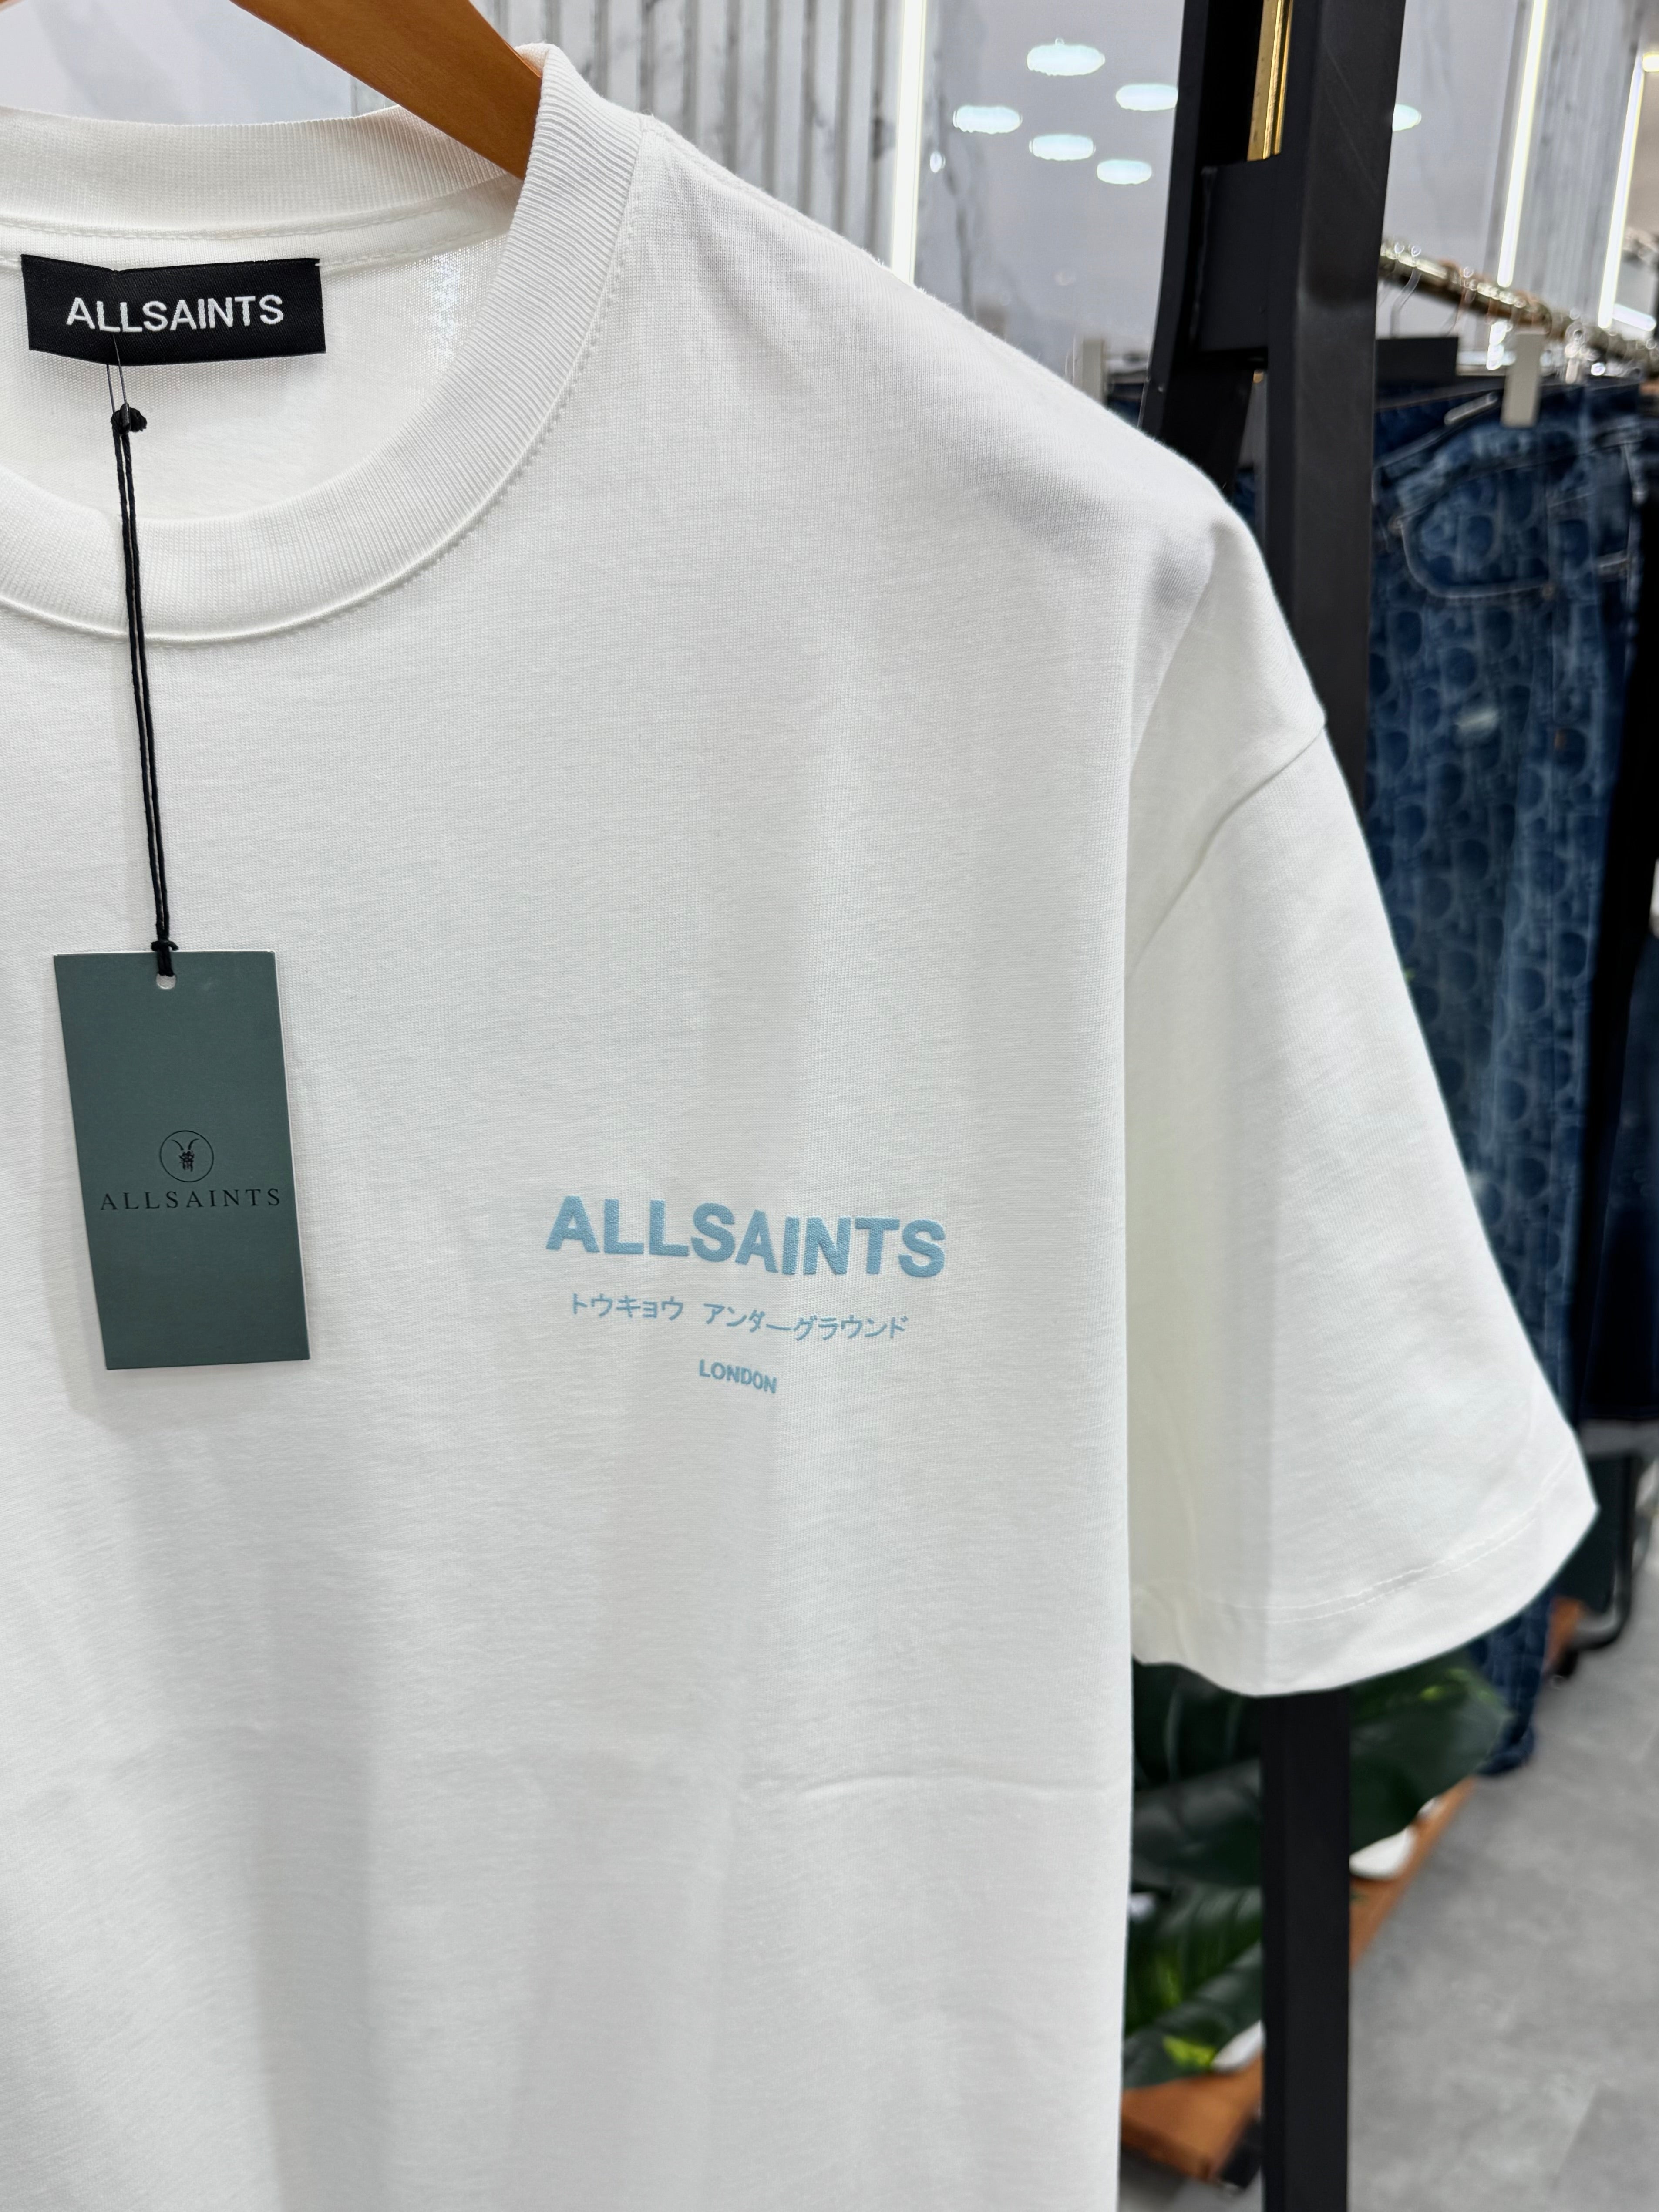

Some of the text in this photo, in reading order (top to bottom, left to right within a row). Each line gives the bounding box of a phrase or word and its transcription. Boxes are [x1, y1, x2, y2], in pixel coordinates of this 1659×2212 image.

[66, 294, 284, 333] ALLSAINTS
[101, 1188, 281, 1211] ALLSAINTS
[545, 1195, 946, 1278] ALLSAINTS
[572, 1293, 909, 1341] トウキョウ アンダーグラウンド
[699, 1358, 777, 1394] LONDON
